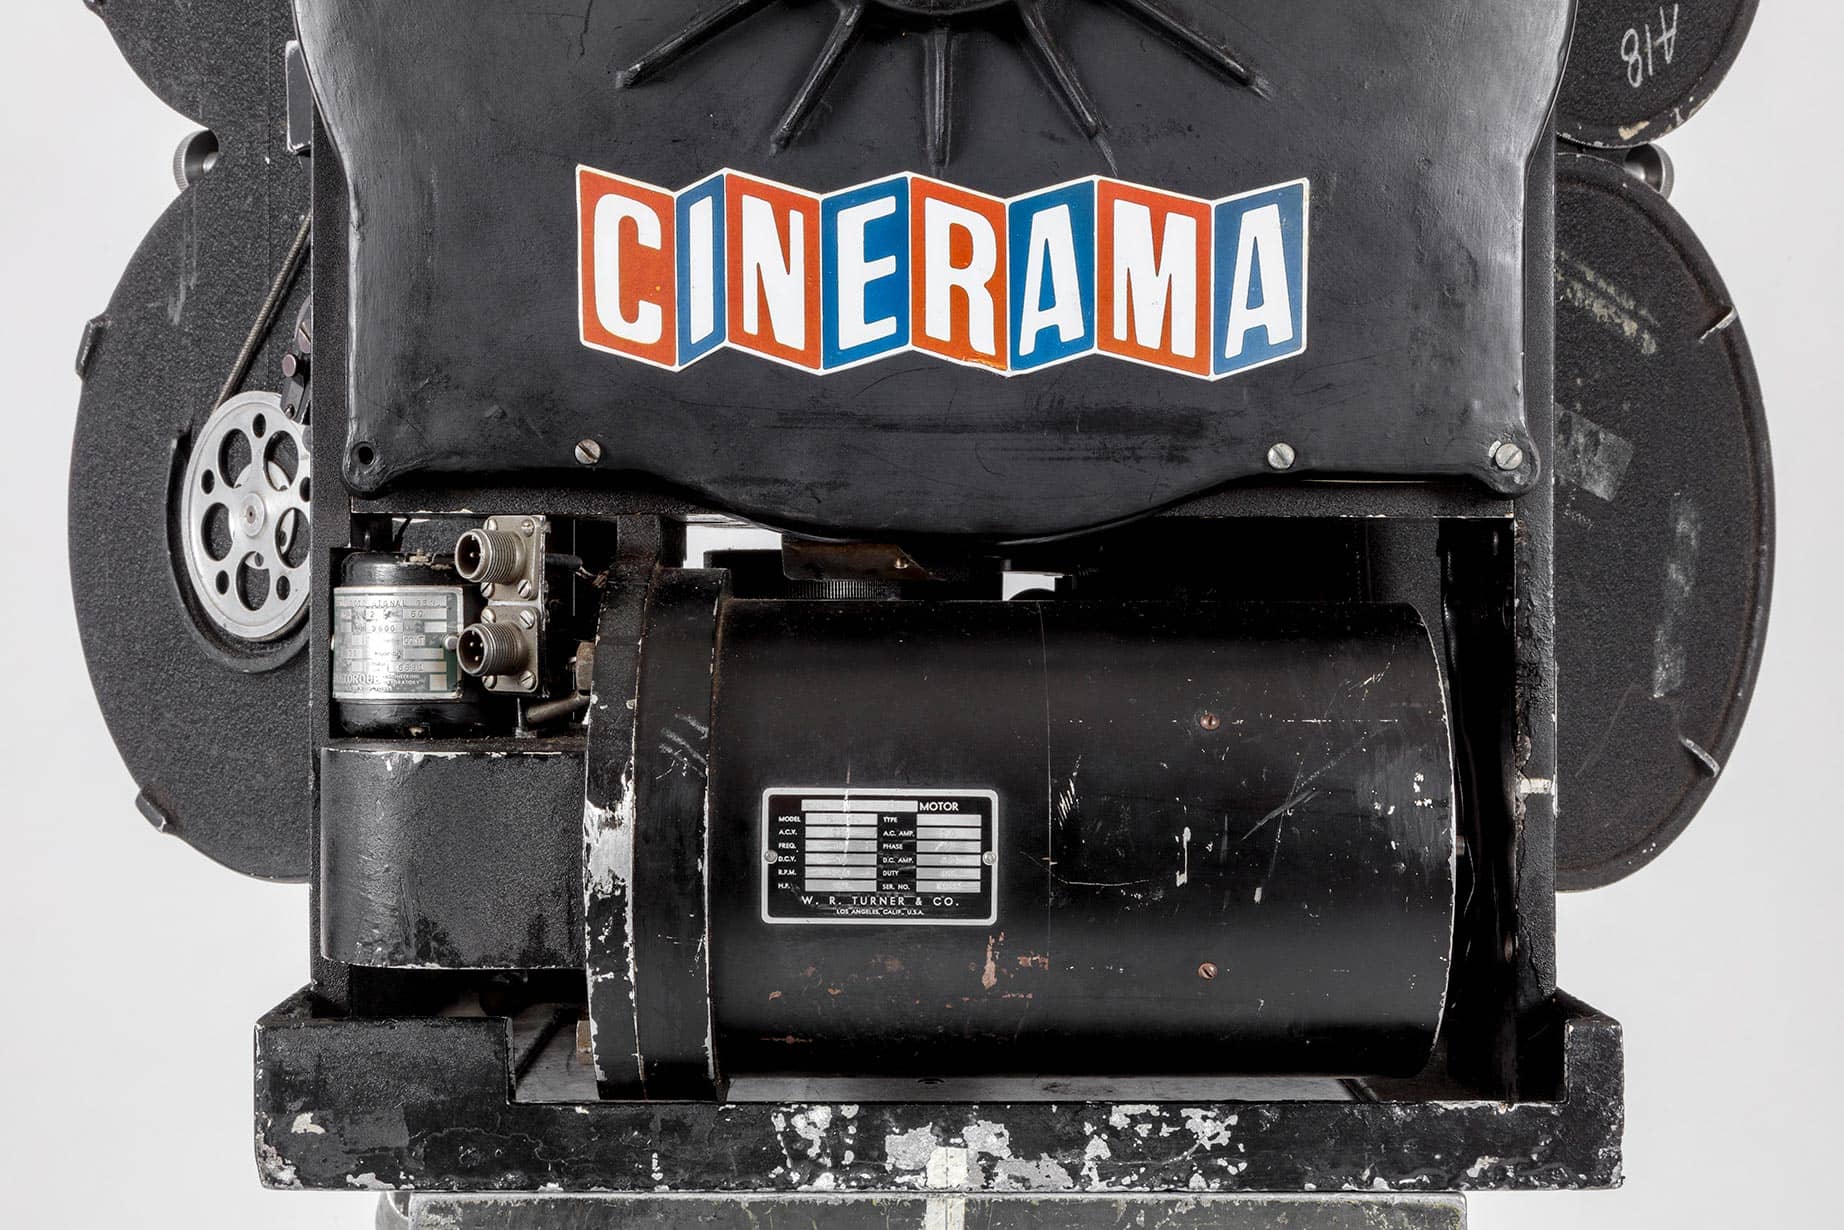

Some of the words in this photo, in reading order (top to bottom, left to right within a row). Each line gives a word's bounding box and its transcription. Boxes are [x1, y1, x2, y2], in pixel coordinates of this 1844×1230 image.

[592, 192, 1296, 360] CINERAMA
[919, 801, 959, 811] MOTOR
[778, 815, 801, 823] MODEL
[801, 895, 819, 905] W.
[829, 895, 842, 905] R.
[851, 896, 905, 906] TURNER
[915, 896, 923, 906] &
[932, 896, 959, 907] CO.
